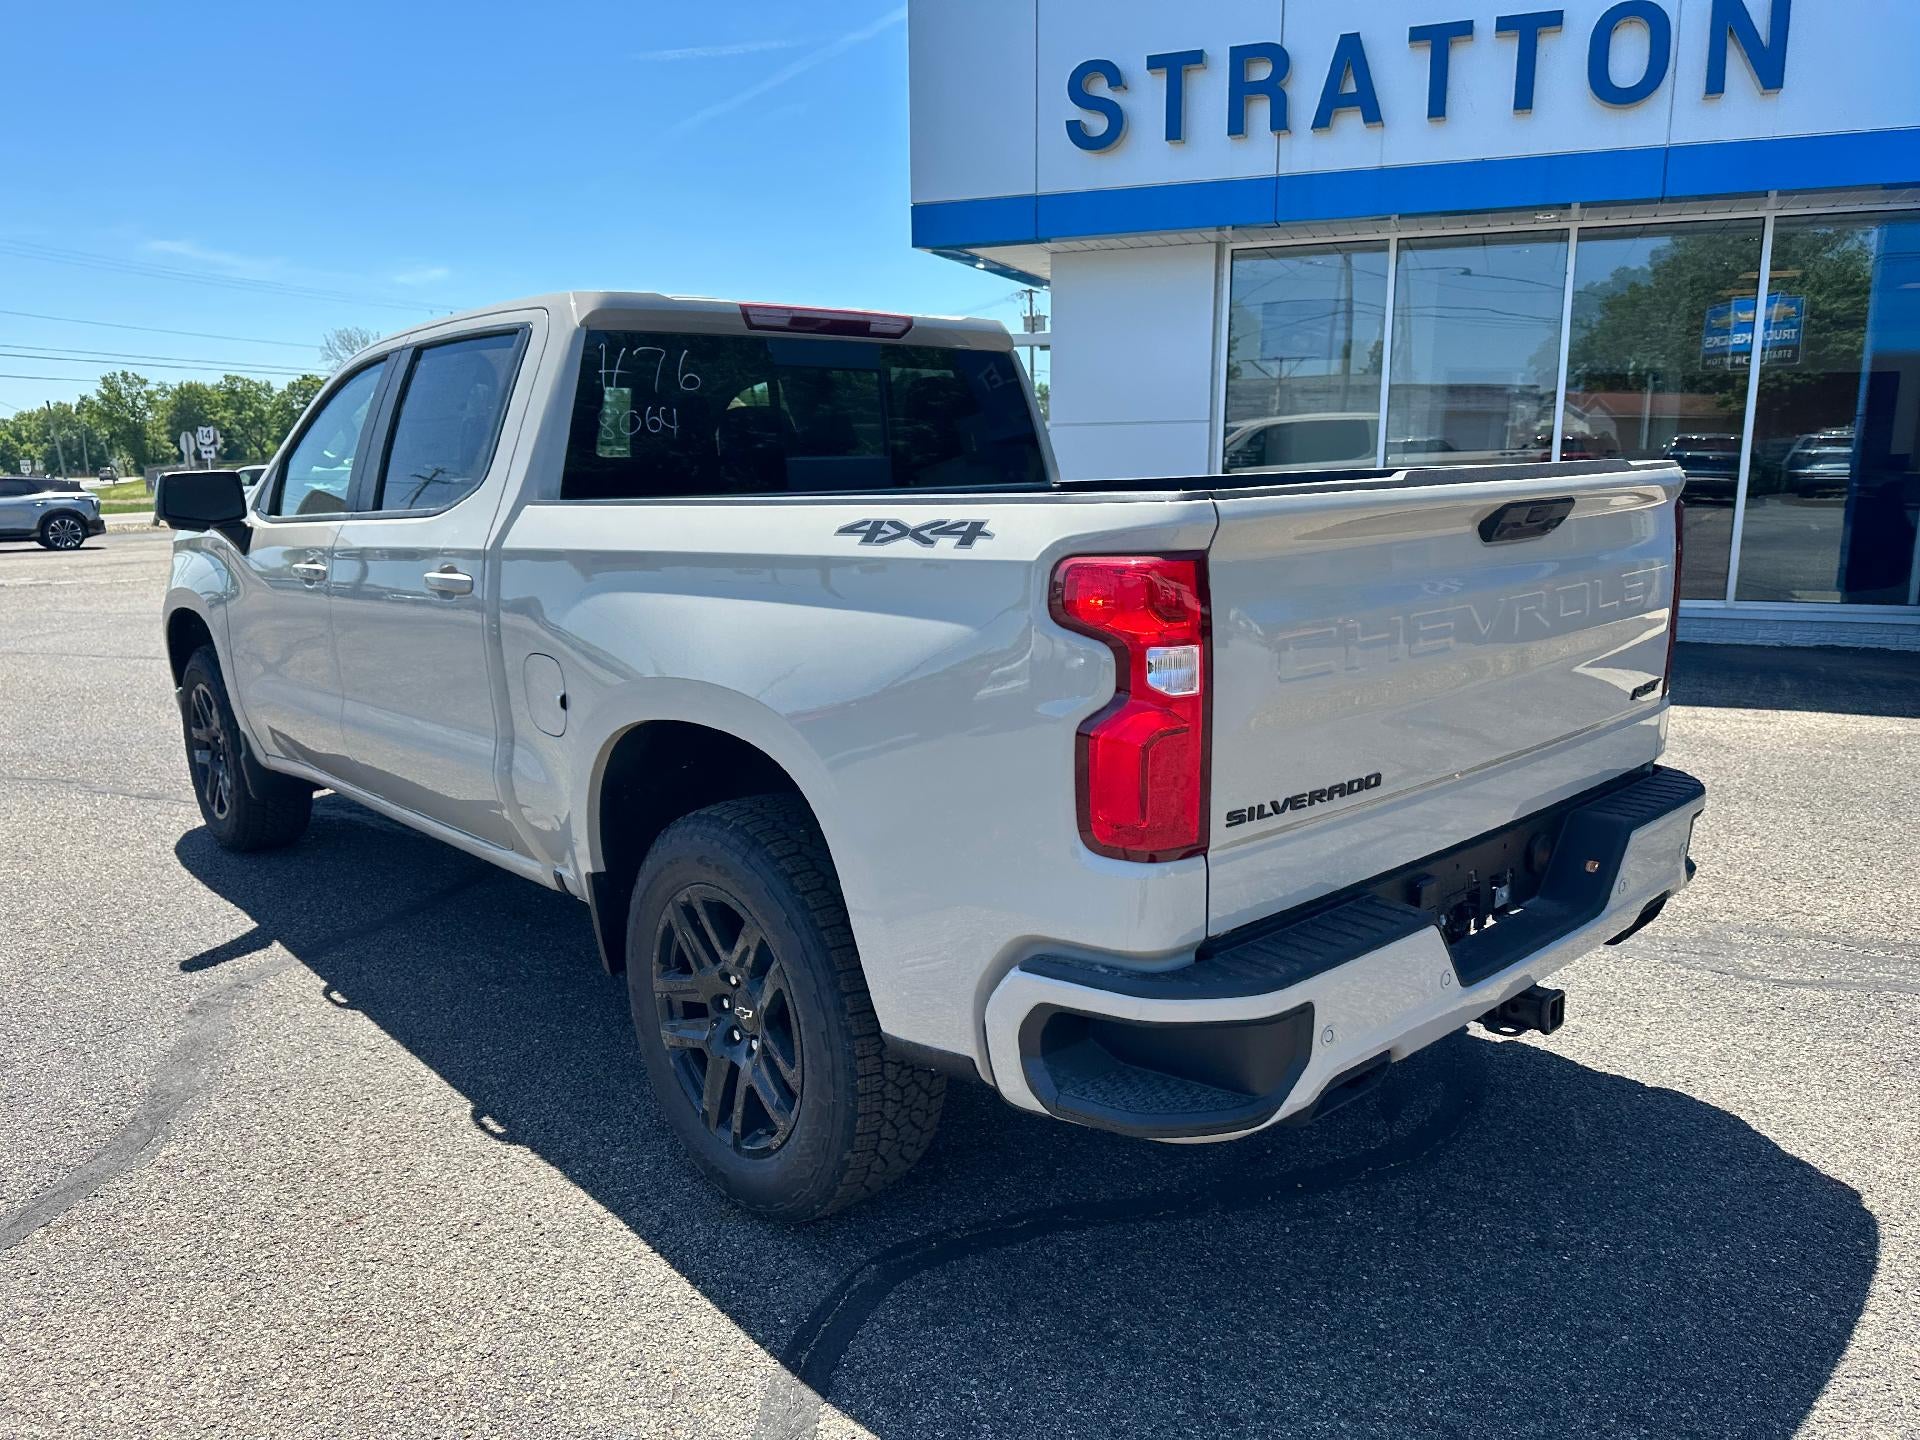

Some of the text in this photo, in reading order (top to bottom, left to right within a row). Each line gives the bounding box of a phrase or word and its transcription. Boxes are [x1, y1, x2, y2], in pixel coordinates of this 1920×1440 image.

[1065, 0, 1792, 153] STRATTON
[201, 430, 211, 440] 14
[599, 406, 680, 439] 8064
[1225, 772, 1382, 828] SILVERADO
